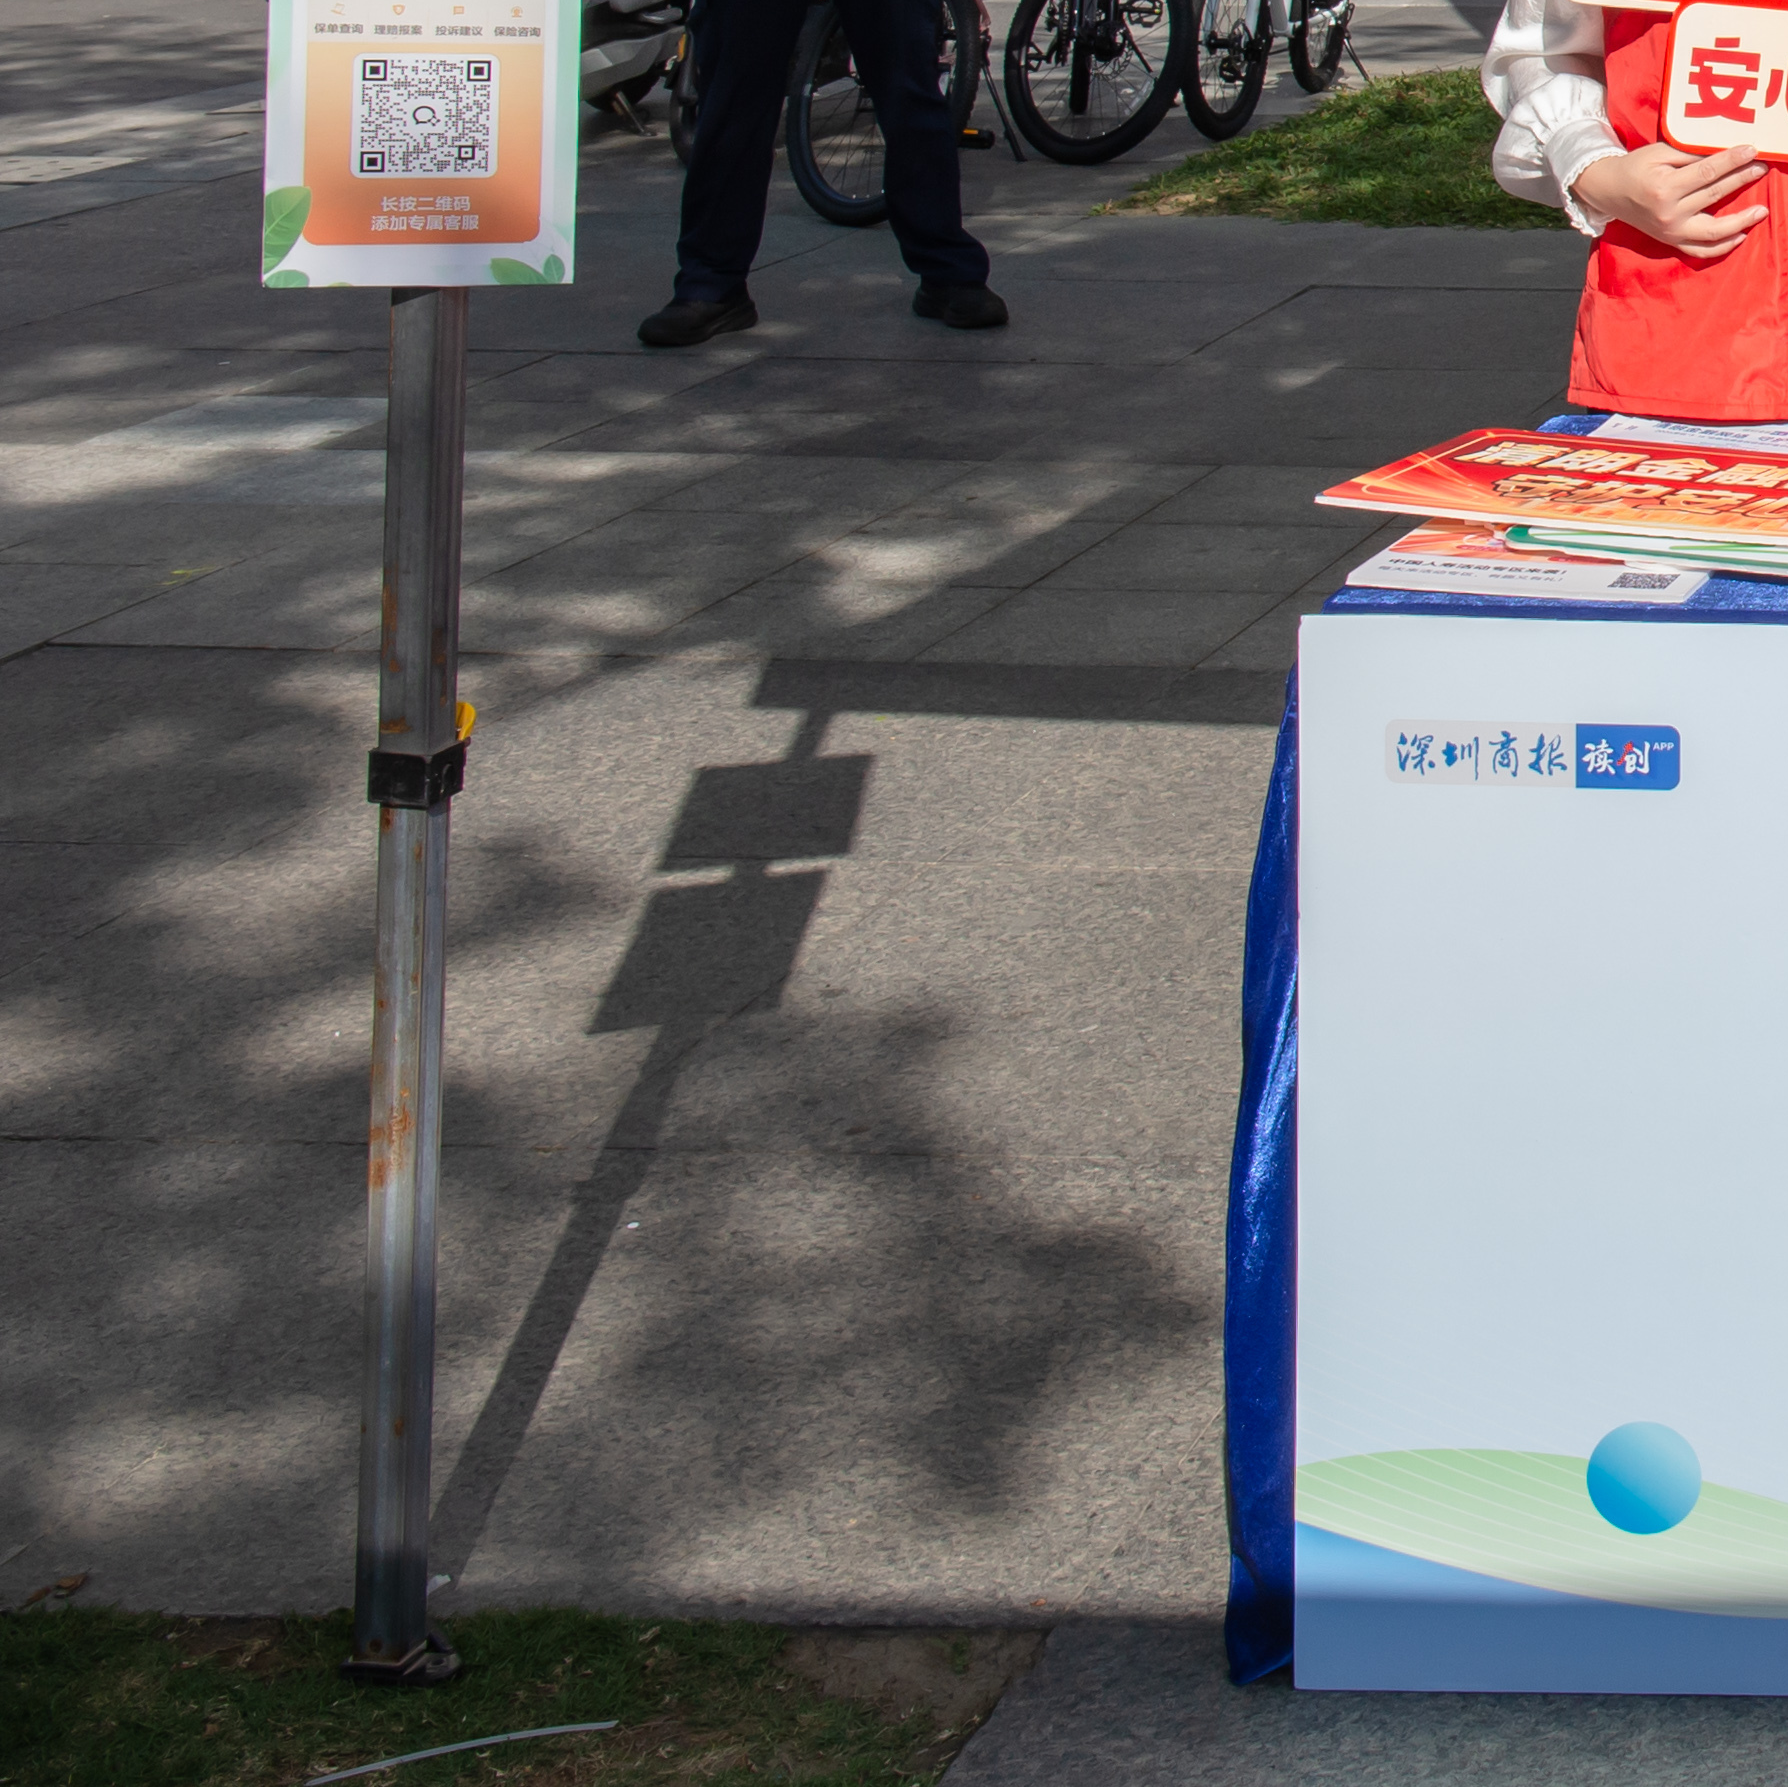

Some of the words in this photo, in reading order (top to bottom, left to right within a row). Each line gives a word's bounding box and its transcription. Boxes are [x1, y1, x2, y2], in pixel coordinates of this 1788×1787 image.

[314, 23, 364, 35] 保单查询
[374, 24, 423, 36] 理赔报案
[435, 25, 483, 37] 投诉建议
[494, 26, 541, 38] 保险咨询
[381, 196, 471, 212] 长按二维码
[371, 214, 480, 232] 添加专属客服
[1394, 730, 1568, 780] 深圳商报
[1653, 741, 1675, 753] APP
[1580, 739, 1653, 777] 读创
